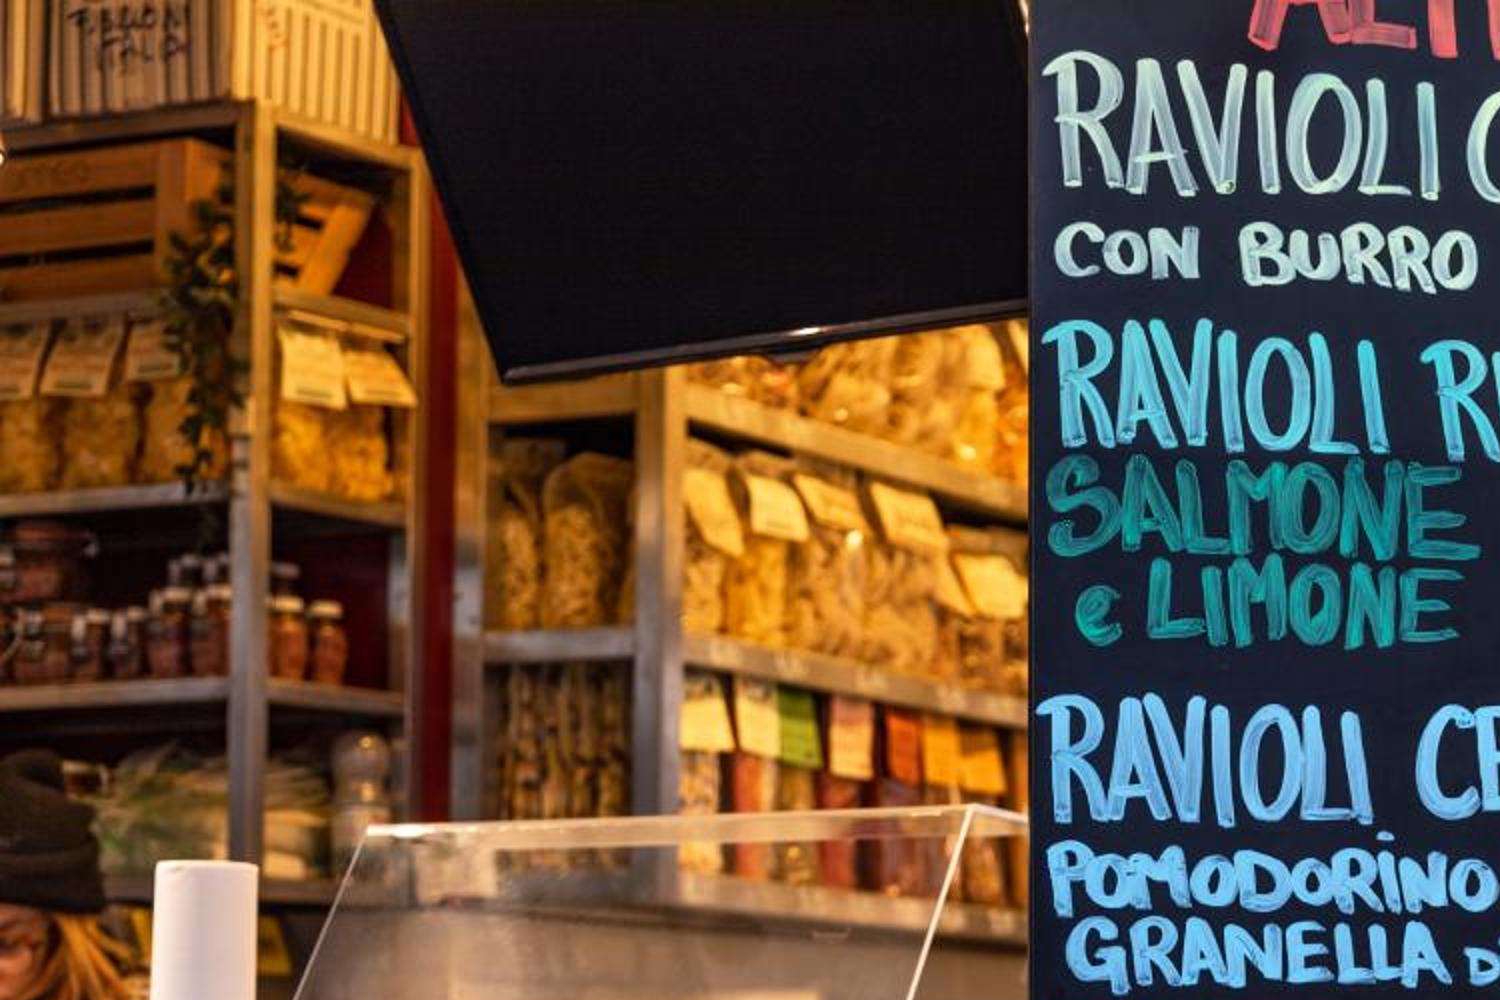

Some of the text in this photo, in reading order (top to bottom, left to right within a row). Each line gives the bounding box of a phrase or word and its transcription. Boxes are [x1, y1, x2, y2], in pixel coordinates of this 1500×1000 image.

[1043, 49, 1438, 200] RAVIOLI
[1054, 221, 1200, 281] CON
[1239, 221, 1478, 296] BURRO
[1042, 318, 1388, 455] RAVIOLI
[1046, 454, 1481, 561] SALMONE
[1074, 556, 1462, 650] e LIMONE
[1036, 692, 1374, 828] RAVIOLI
[1066, 917, 1451, 996] GRANELLA
